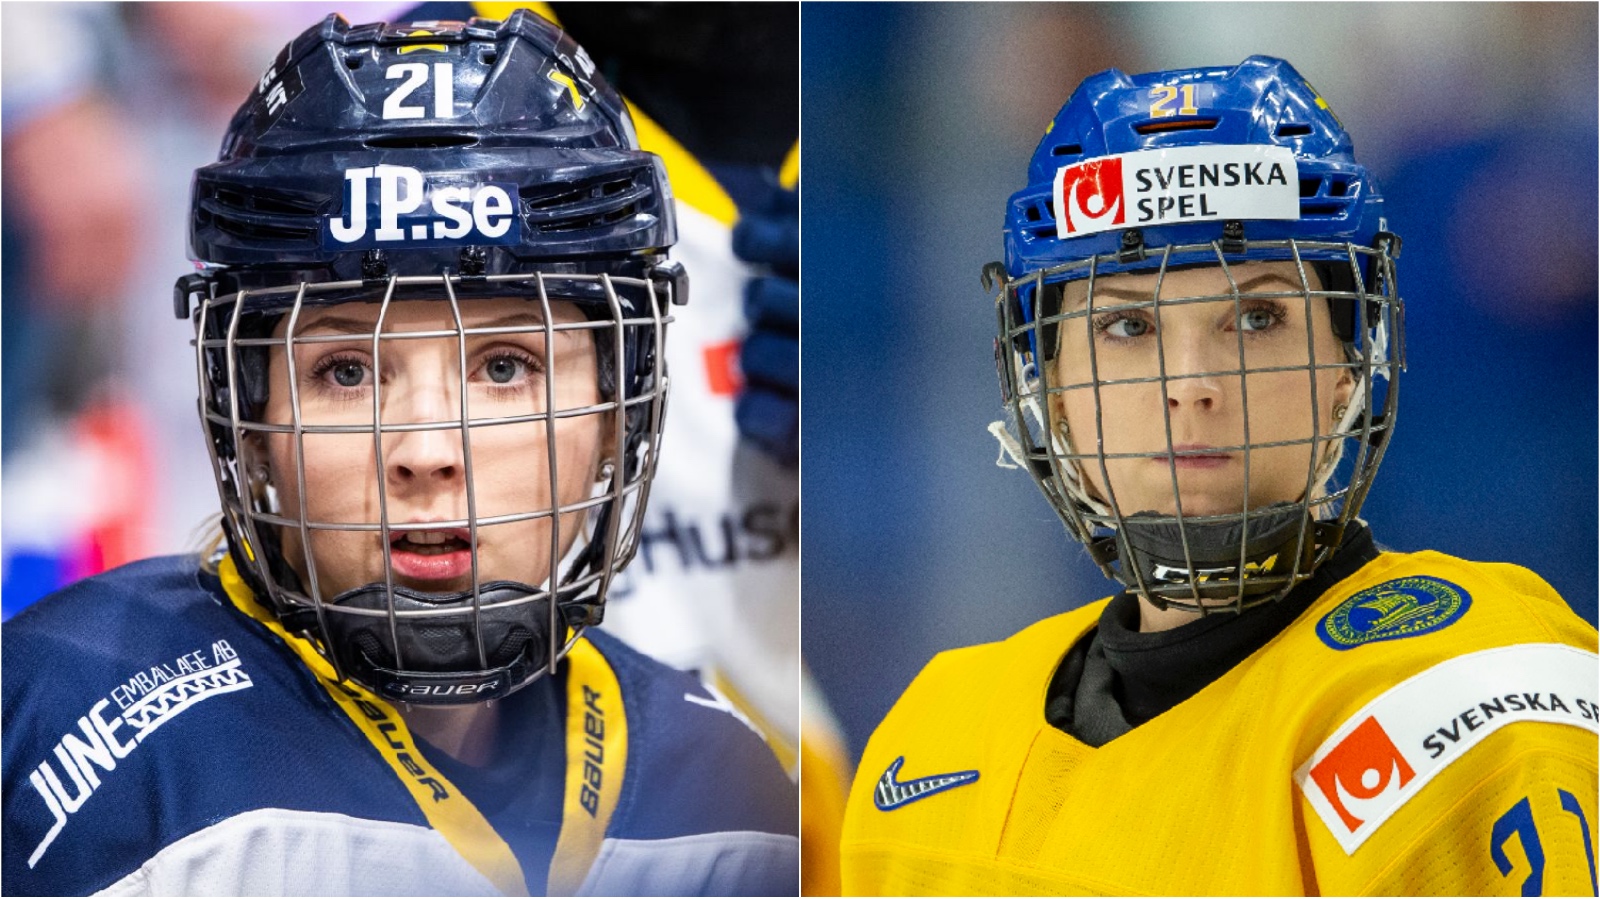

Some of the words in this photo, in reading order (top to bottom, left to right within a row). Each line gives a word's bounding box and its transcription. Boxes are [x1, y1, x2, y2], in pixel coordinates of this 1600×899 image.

[382, 63, 453, 119] 21
[1149, 84, 1198, 118] 21
[330, 164, 513, 243] JP.se
[1136, 162, 1287, 192] SVENSKA
[1138, 194, 1218, 222] SPEL
[110, 650, 211, 709] EMBALLAGE
[212, 639, 238, 665] AB
[1422, 692, 1571, 759] SVENSKA
[28, 698, 138, 869] JUNE
